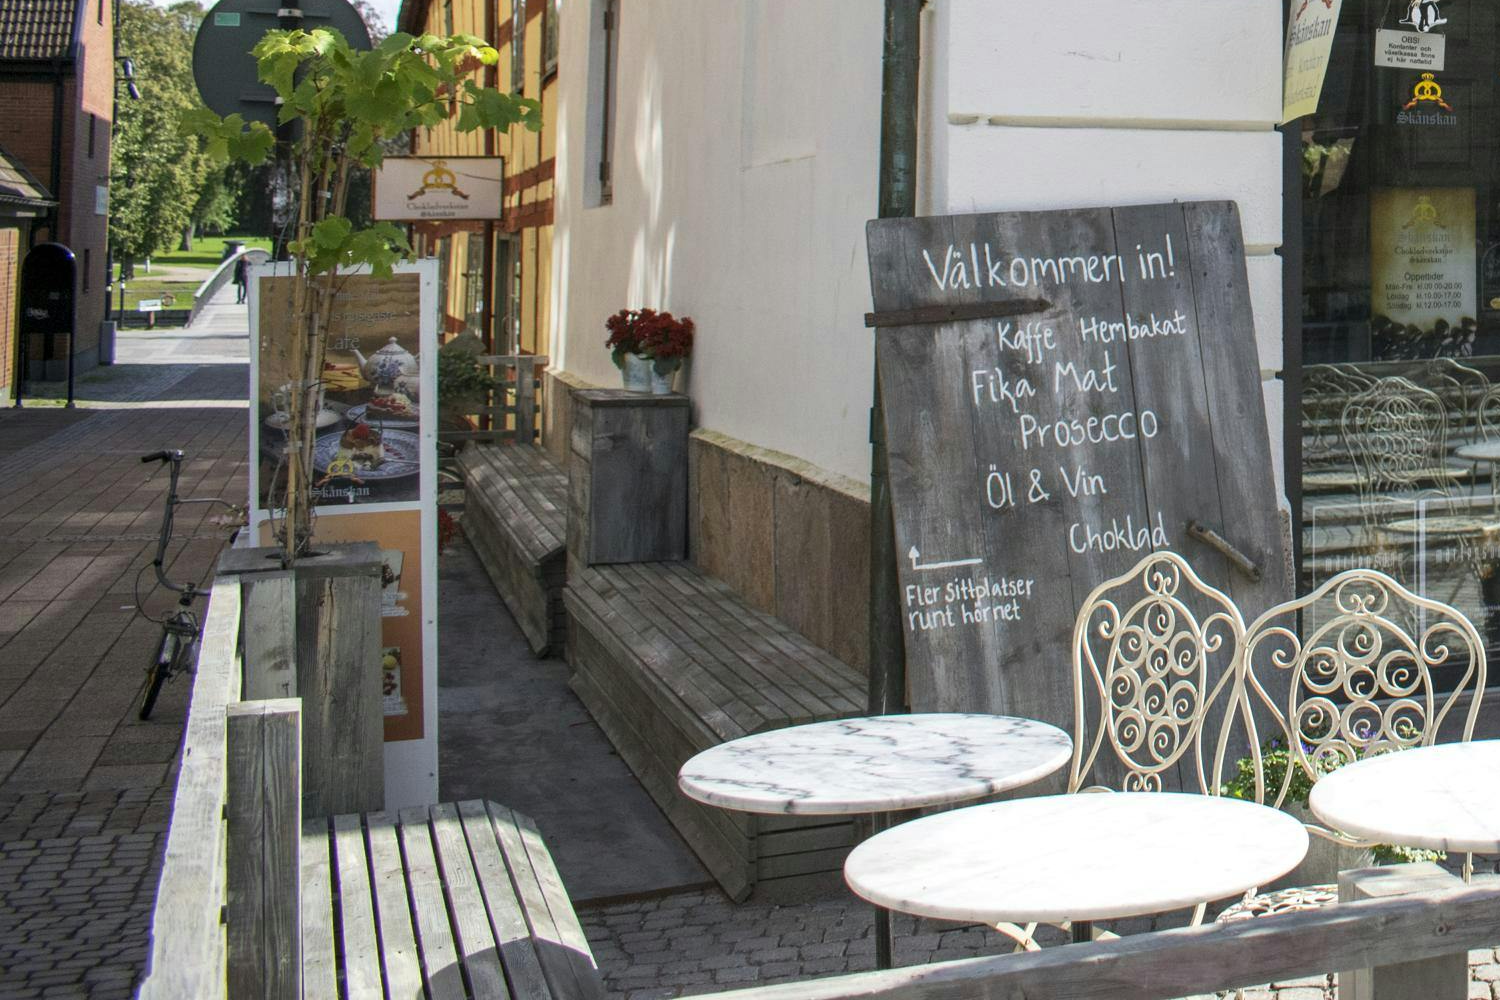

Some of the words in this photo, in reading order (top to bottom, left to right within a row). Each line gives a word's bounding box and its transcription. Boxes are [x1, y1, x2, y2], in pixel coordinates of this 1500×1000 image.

[1401, 35, 1420, 44] OBS!
[1396, 110, 1457, 125] Skånskan
[923, 243, 1125, 291] Välkommen
[1136, 233, 1175, 279] in!
[998, 321, 1056, 364] Kaffe
[1080, 309, 1187, 344] Hembakat
[972, 367, 1036, 413] Fika
[1055, 350, 1117, 393] Mat
[1020, 410, 1158, 450] Prosecco
[986, 463, 1016, 509] Öl
[1027, 468, 1050, 503] &
[1060, 465, 1107, 498] Vin
[1069, 511, 1170, 554] Choklad
[906, 584, 940, 606] Fler
[909, 604, 955, 630] runt
[961, 598, 1020, 624] hörnet
